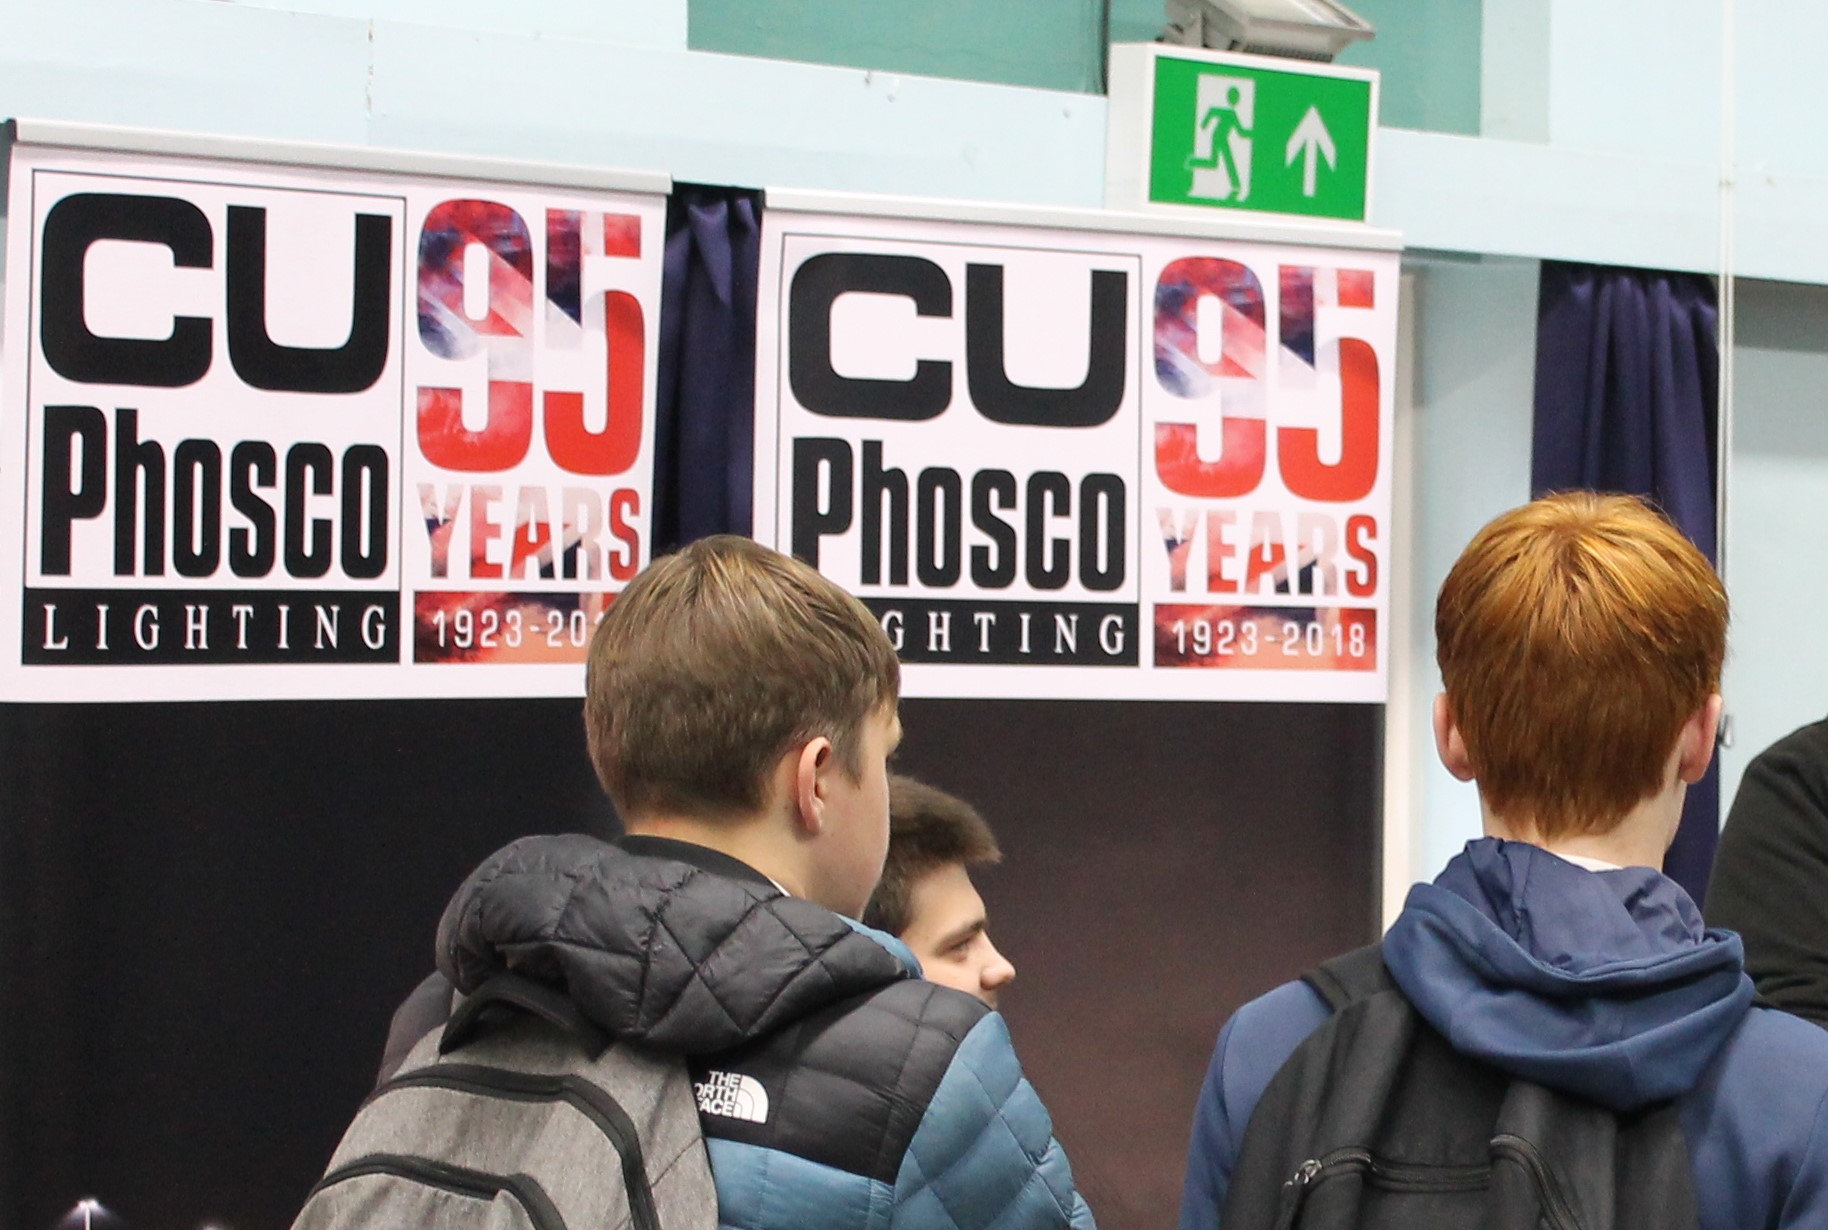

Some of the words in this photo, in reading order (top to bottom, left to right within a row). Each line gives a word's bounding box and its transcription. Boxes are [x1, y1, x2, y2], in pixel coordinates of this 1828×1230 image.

[40, 193, 392, 394] CU
[416, 198, 645, 476] 95
[789, 252, 1128, 428] CU
[1153, 255, 1380, 502] 95
[40, 404, 389, 580] Phosco
[417, 482, 640, 581] YEARS
[792, 437, 1125, 591] Phosco
[1155, 508, 1377, 598] YEARS
[43, 604, 387, 650] LIGHTING
[432, 609, 606, 648] 1923-20
[881, 611, 1125, 655] GHTING
[1171, 619, 1366, 658] 1923-2018
[694, 1082, 738, 1103] ORTH
[698, 1098, 735, 1117] ACE
[709, 1070, 741, 1088] THE
